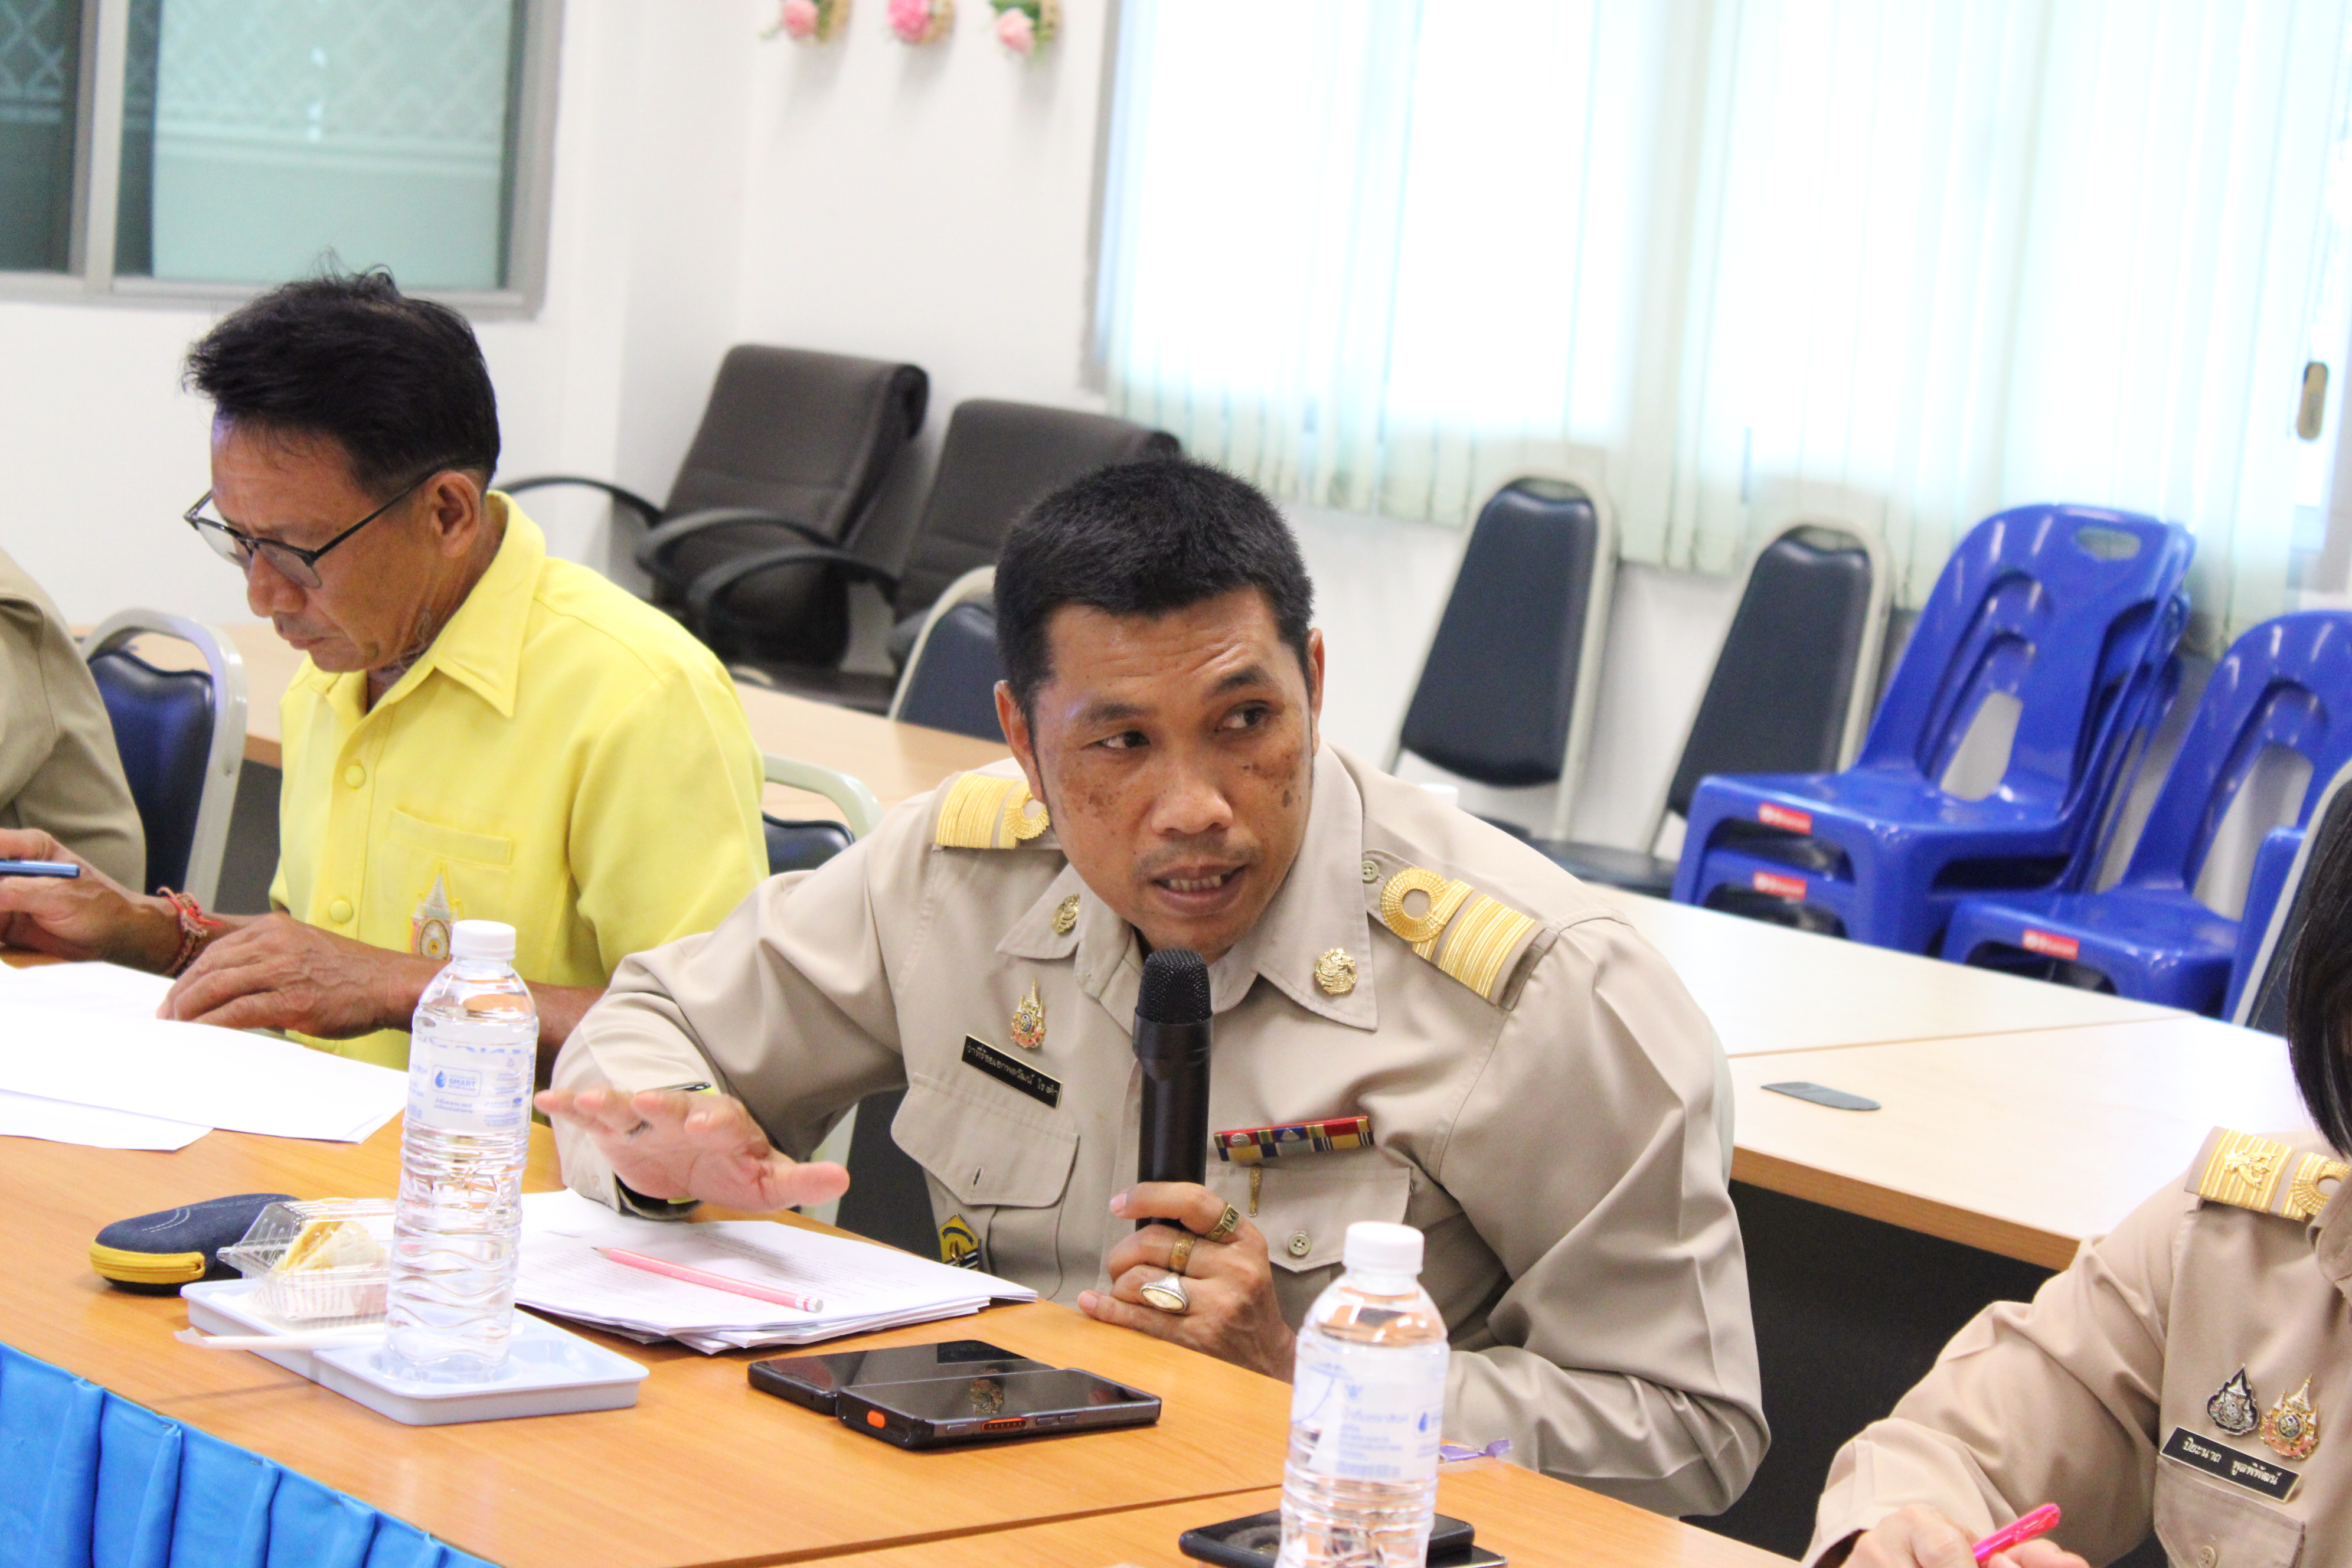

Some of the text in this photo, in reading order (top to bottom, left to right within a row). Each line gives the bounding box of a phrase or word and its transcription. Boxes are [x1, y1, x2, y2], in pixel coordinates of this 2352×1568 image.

[449, 1078, 476, 1087] SMART
[2230, 1460, 2283, 1485] พูลพิพัฒน์
